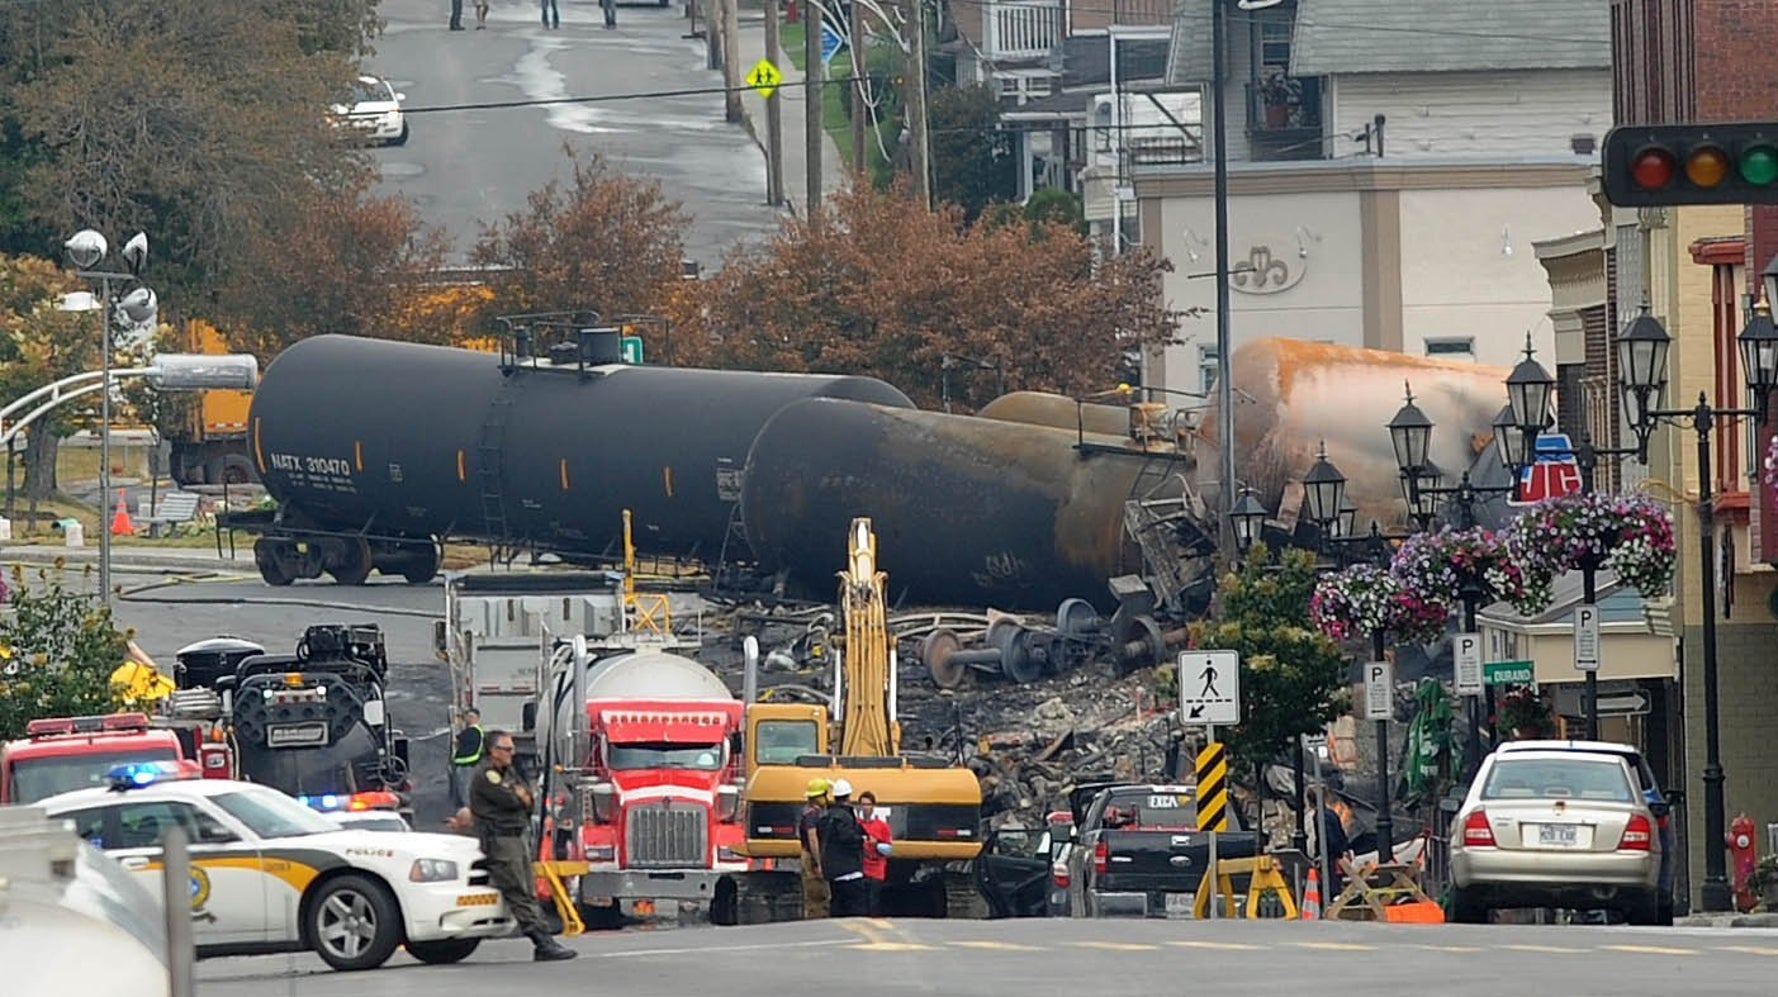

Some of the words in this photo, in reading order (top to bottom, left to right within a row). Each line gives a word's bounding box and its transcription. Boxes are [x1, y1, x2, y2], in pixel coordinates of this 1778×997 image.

[271, 453, 302, 471] NATX
[306, 457, 351, 476] 310470
[1581, 610, 1592, 627] P
[1462, 639, 1473, 655] P
[1372, 666, 1383, 682] P
[1493, 669, 1531, 682] DURAND
